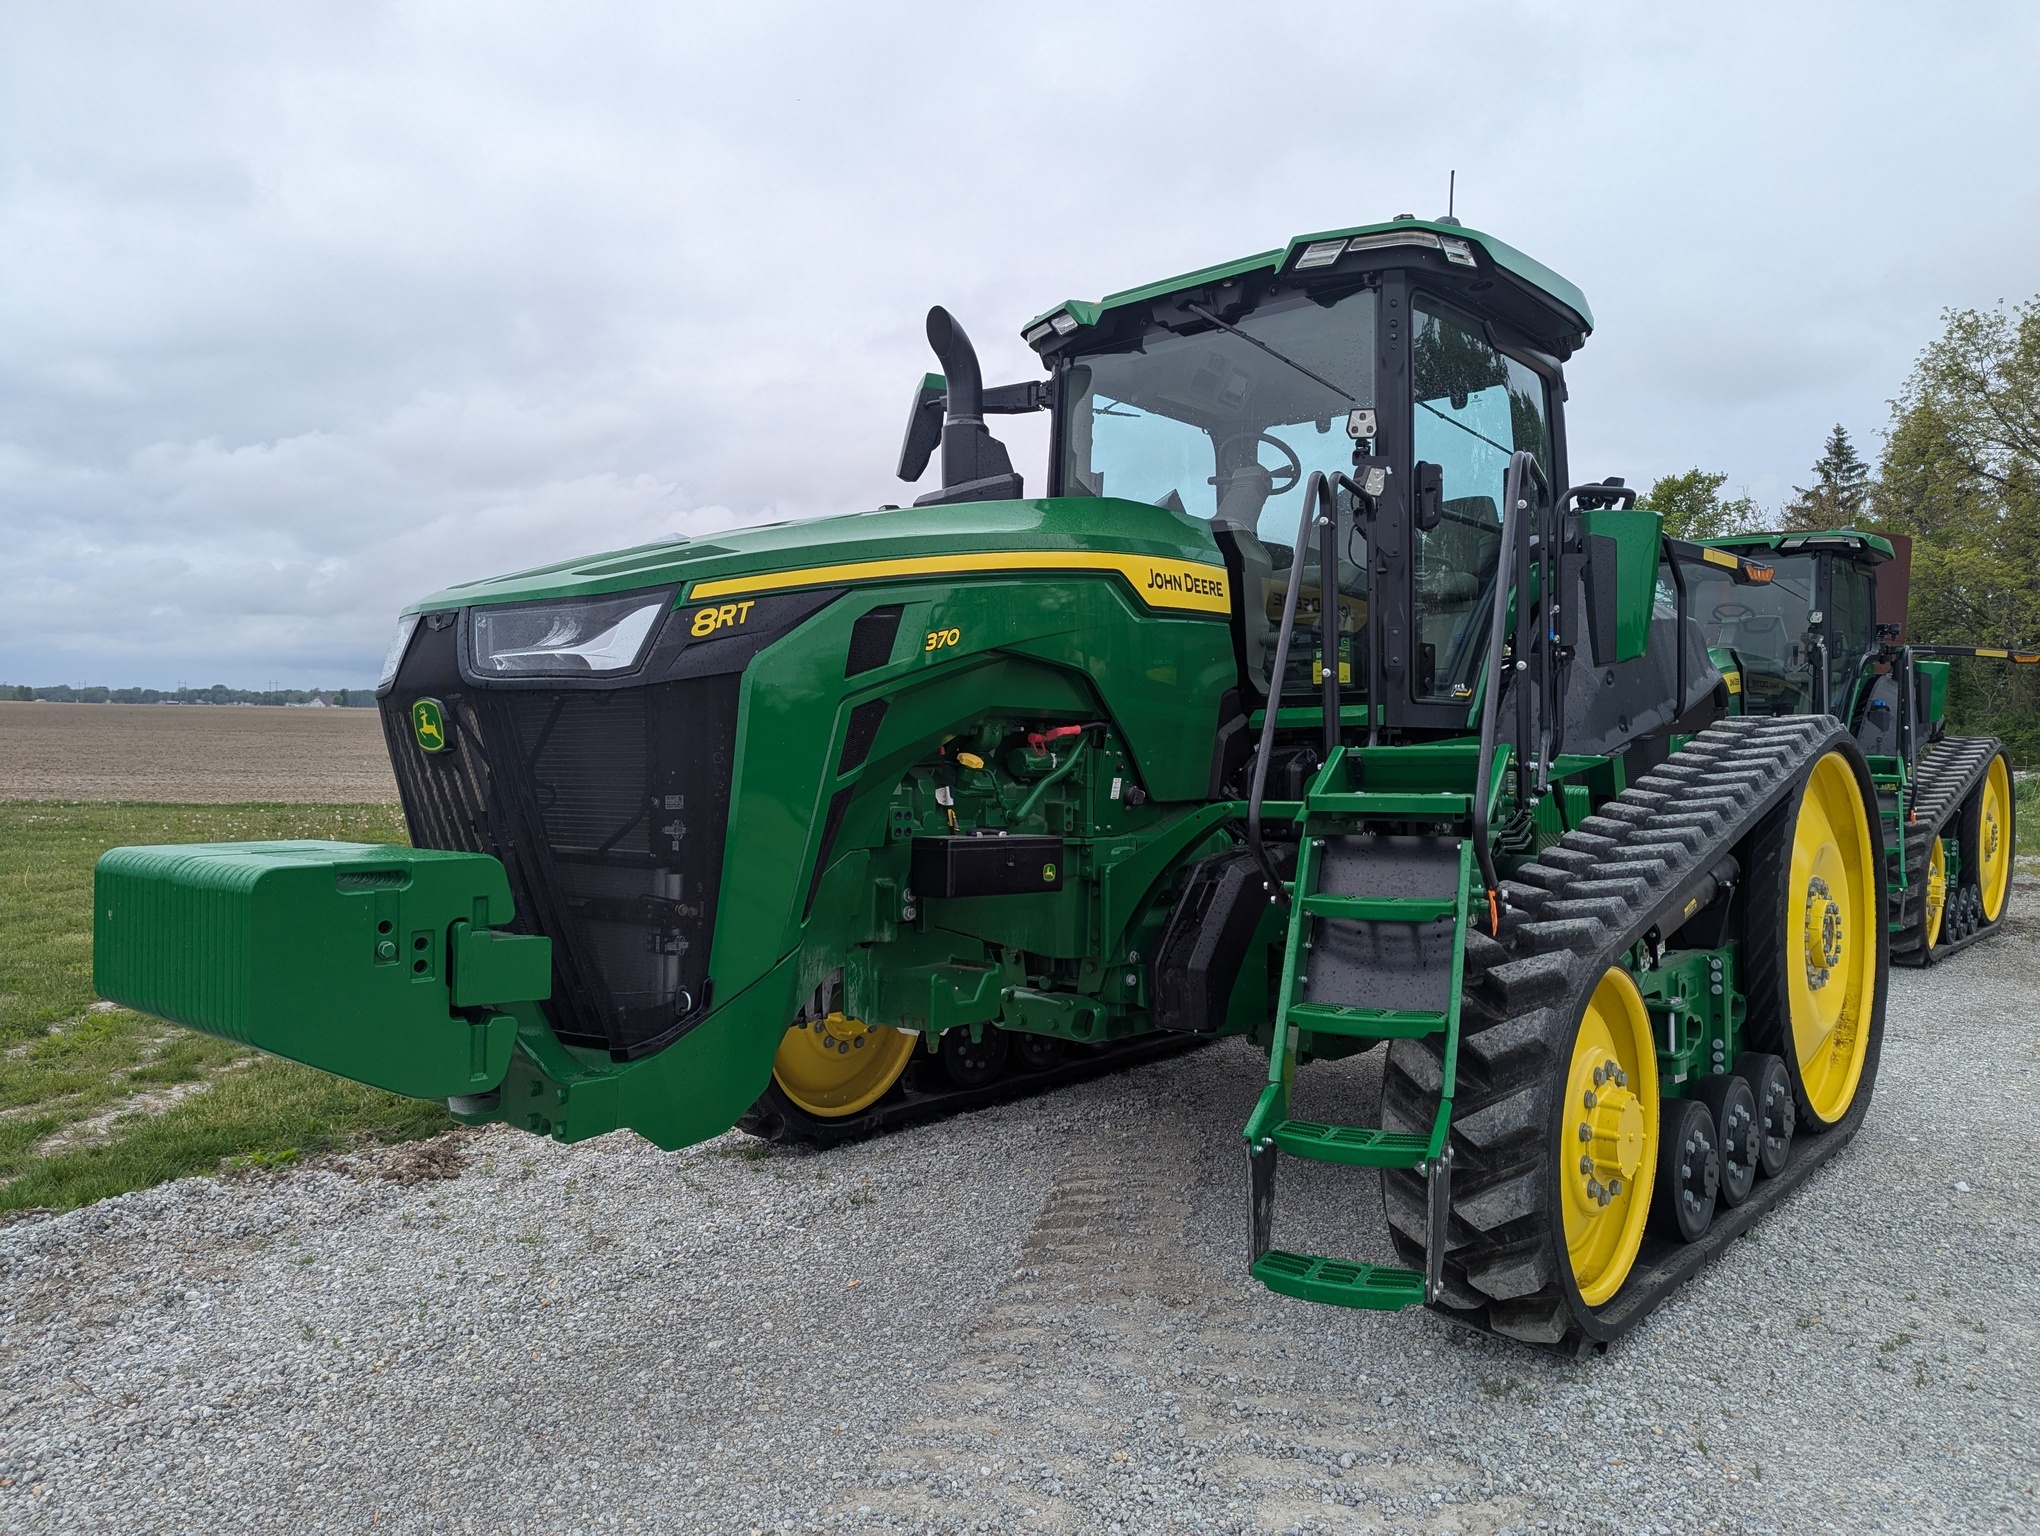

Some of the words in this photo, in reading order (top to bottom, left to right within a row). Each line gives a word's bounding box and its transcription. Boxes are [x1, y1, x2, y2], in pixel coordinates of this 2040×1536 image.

[1147, 568, 1182, 592] JOHN
[1183, 572, 1224, 597] DEERE
[690, 600, 756, 637] 8RT
[924, 627, 960, 651] 370
